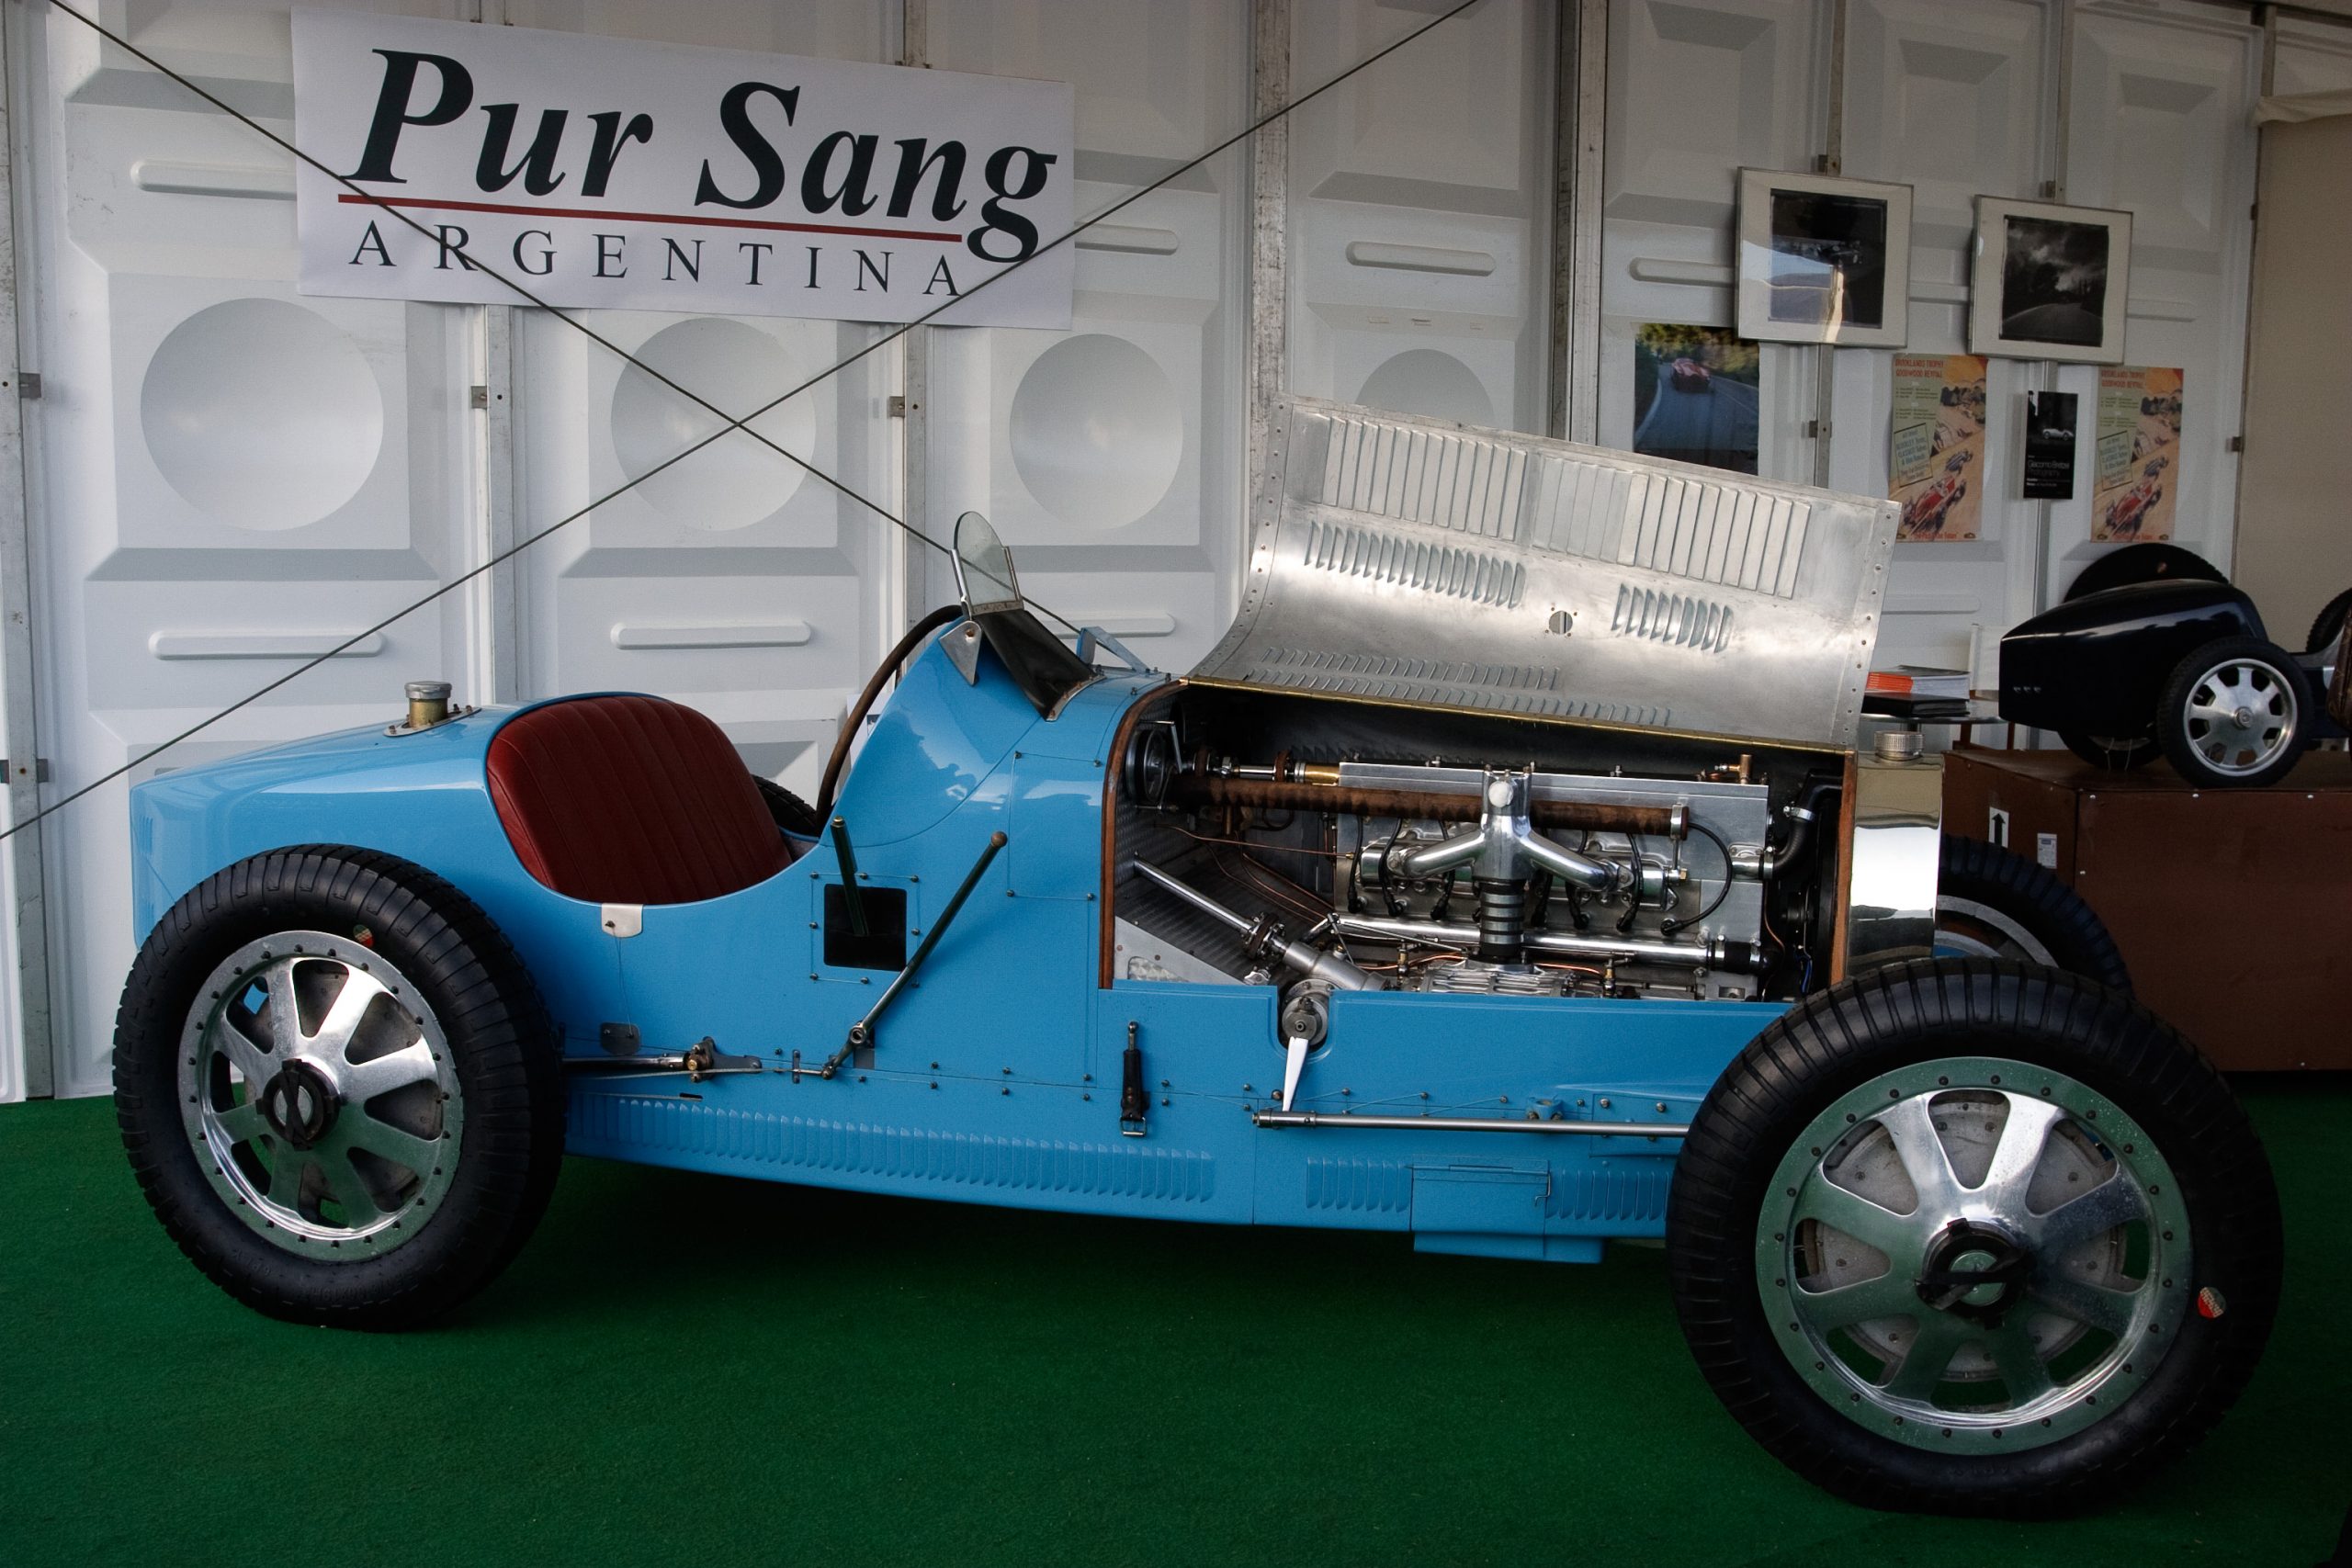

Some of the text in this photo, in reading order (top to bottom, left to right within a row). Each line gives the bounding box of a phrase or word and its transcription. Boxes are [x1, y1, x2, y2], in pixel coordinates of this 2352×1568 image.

[340, 49, 1057, 263] Pur Sang
[348, 219, 963, 297] ARGENTINA
